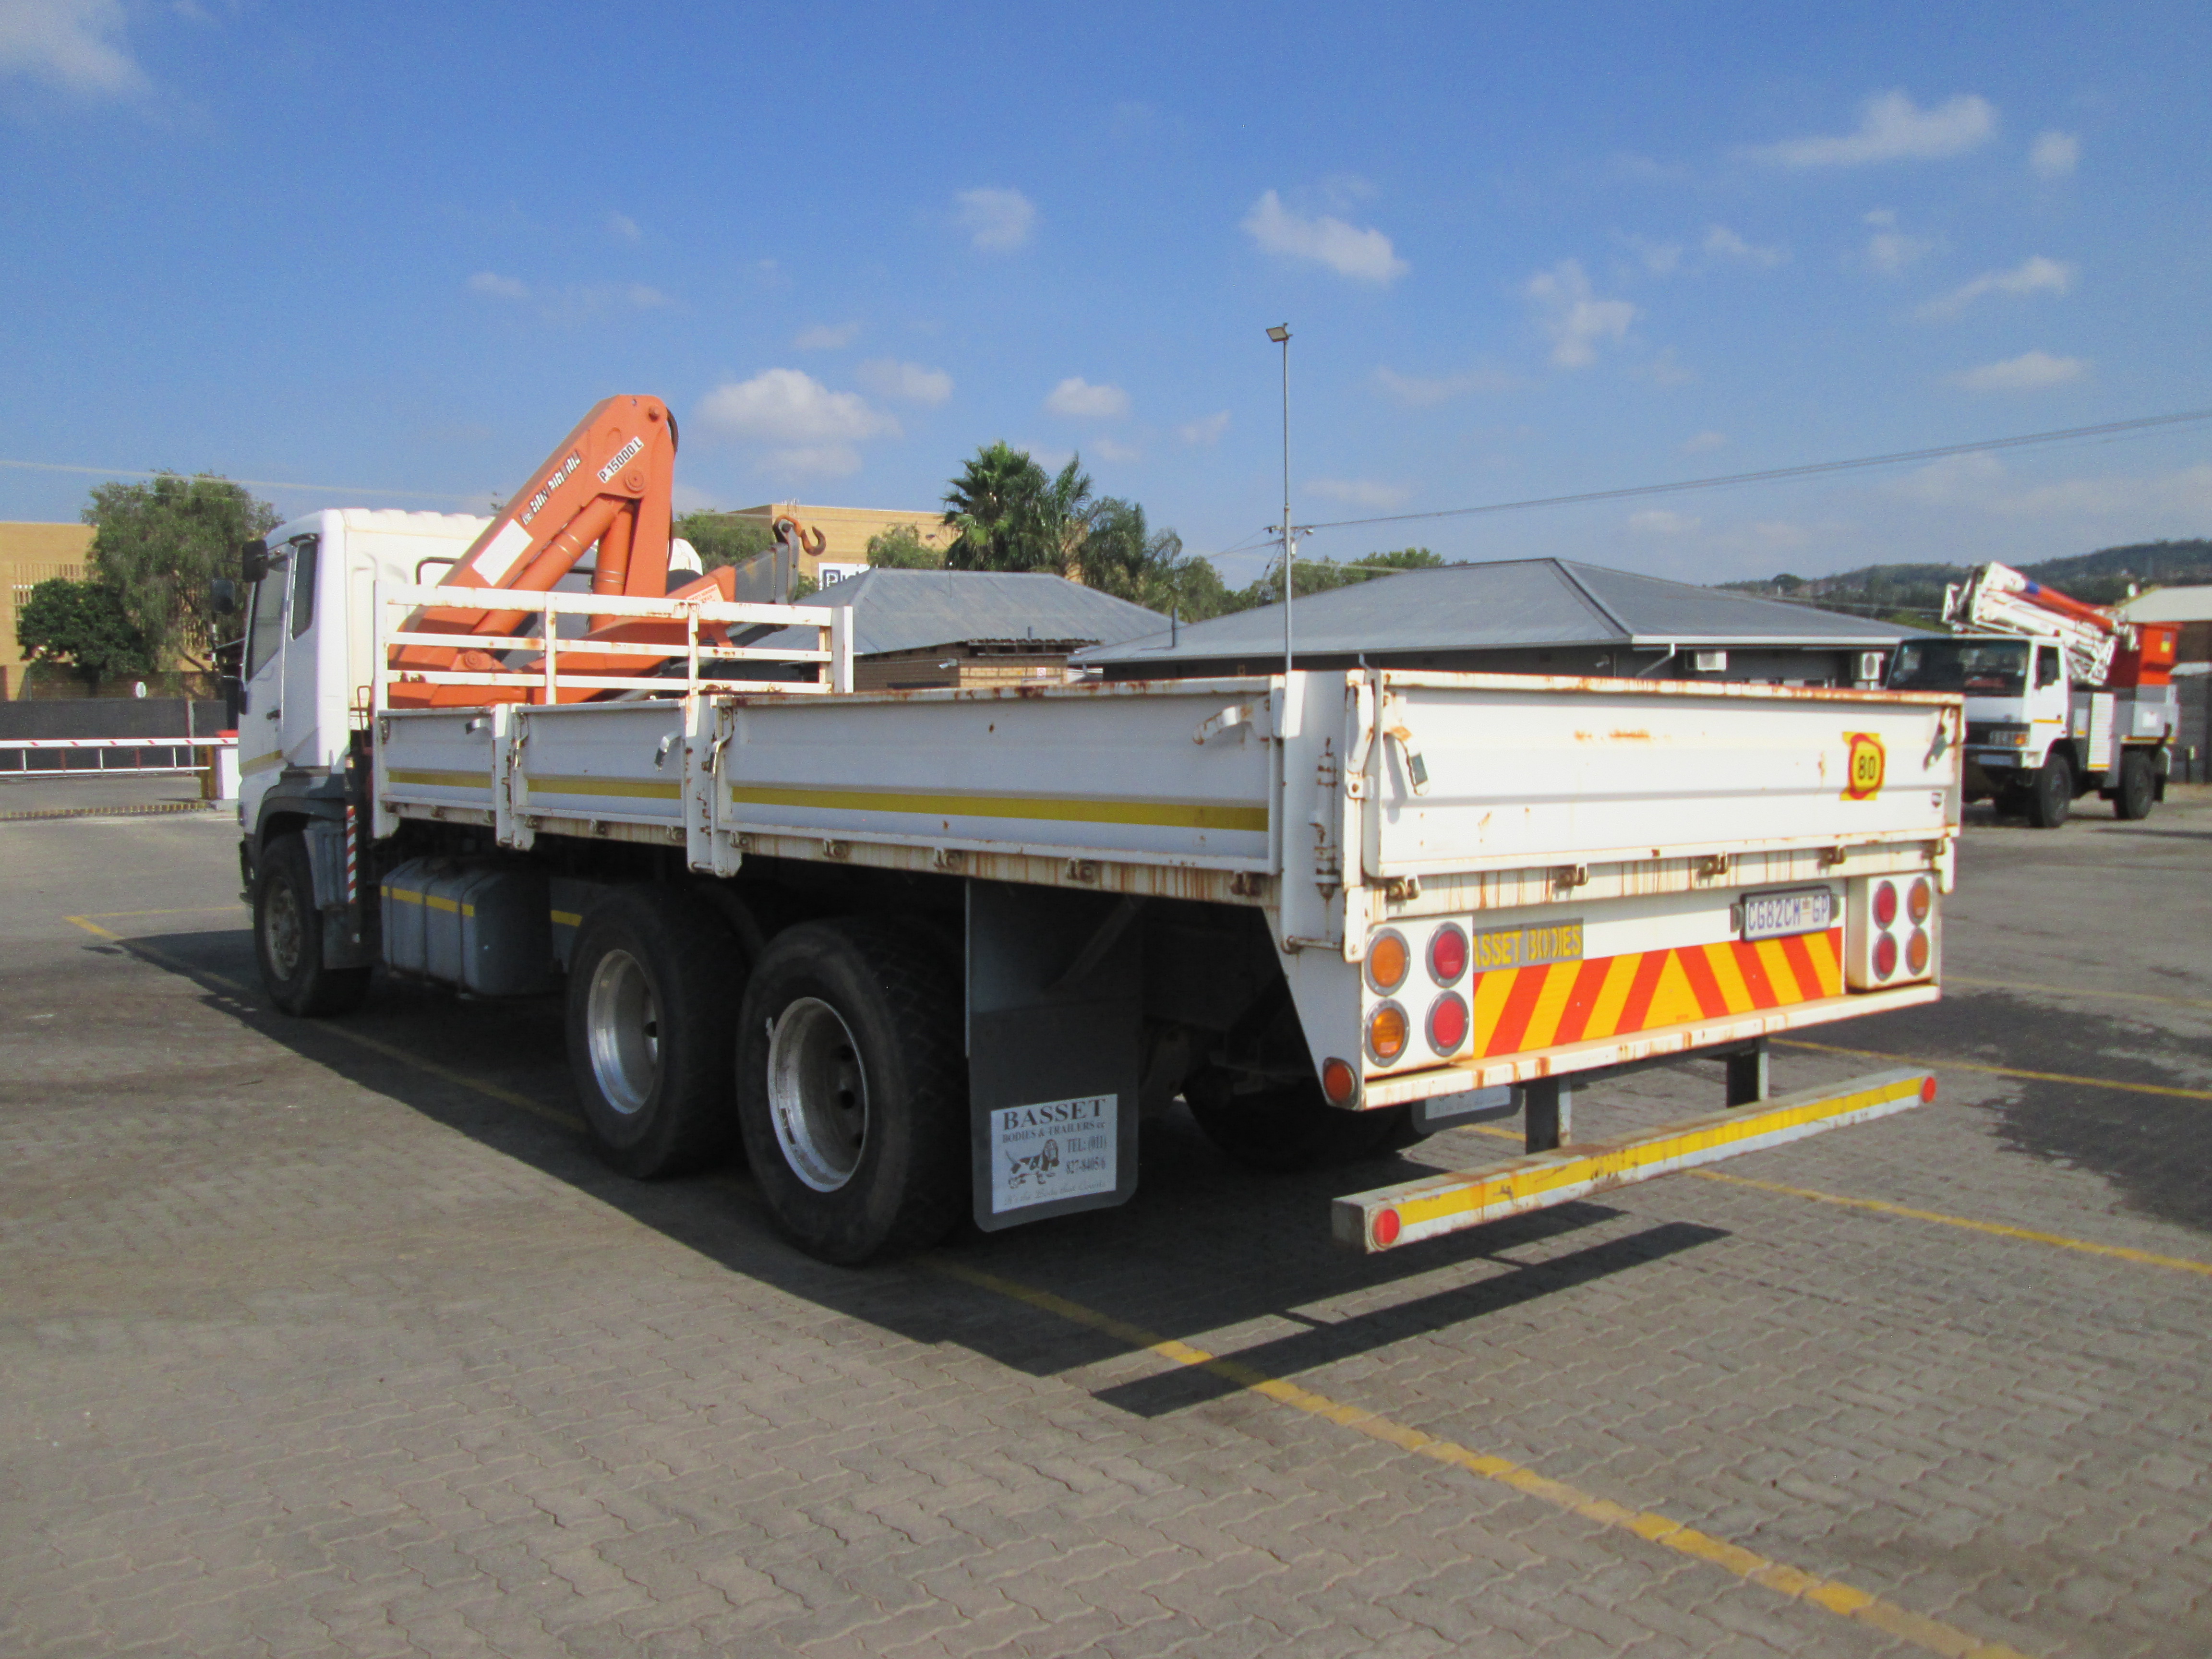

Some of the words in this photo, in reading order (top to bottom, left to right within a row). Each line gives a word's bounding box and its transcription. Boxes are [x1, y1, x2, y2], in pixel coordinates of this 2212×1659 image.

[599, 471, 607, 482] P
[607, 445, 636, 473] 15000
[1859, 755, 1876, 780] 80
[1527, 924, 1583, 961] BODIES
[1003, 1098, 1107, 1130] BASSET
[1002, 1130, 1036, 1143] BODIES
[1048, 1121, 1095, 1135] TRAILERS
